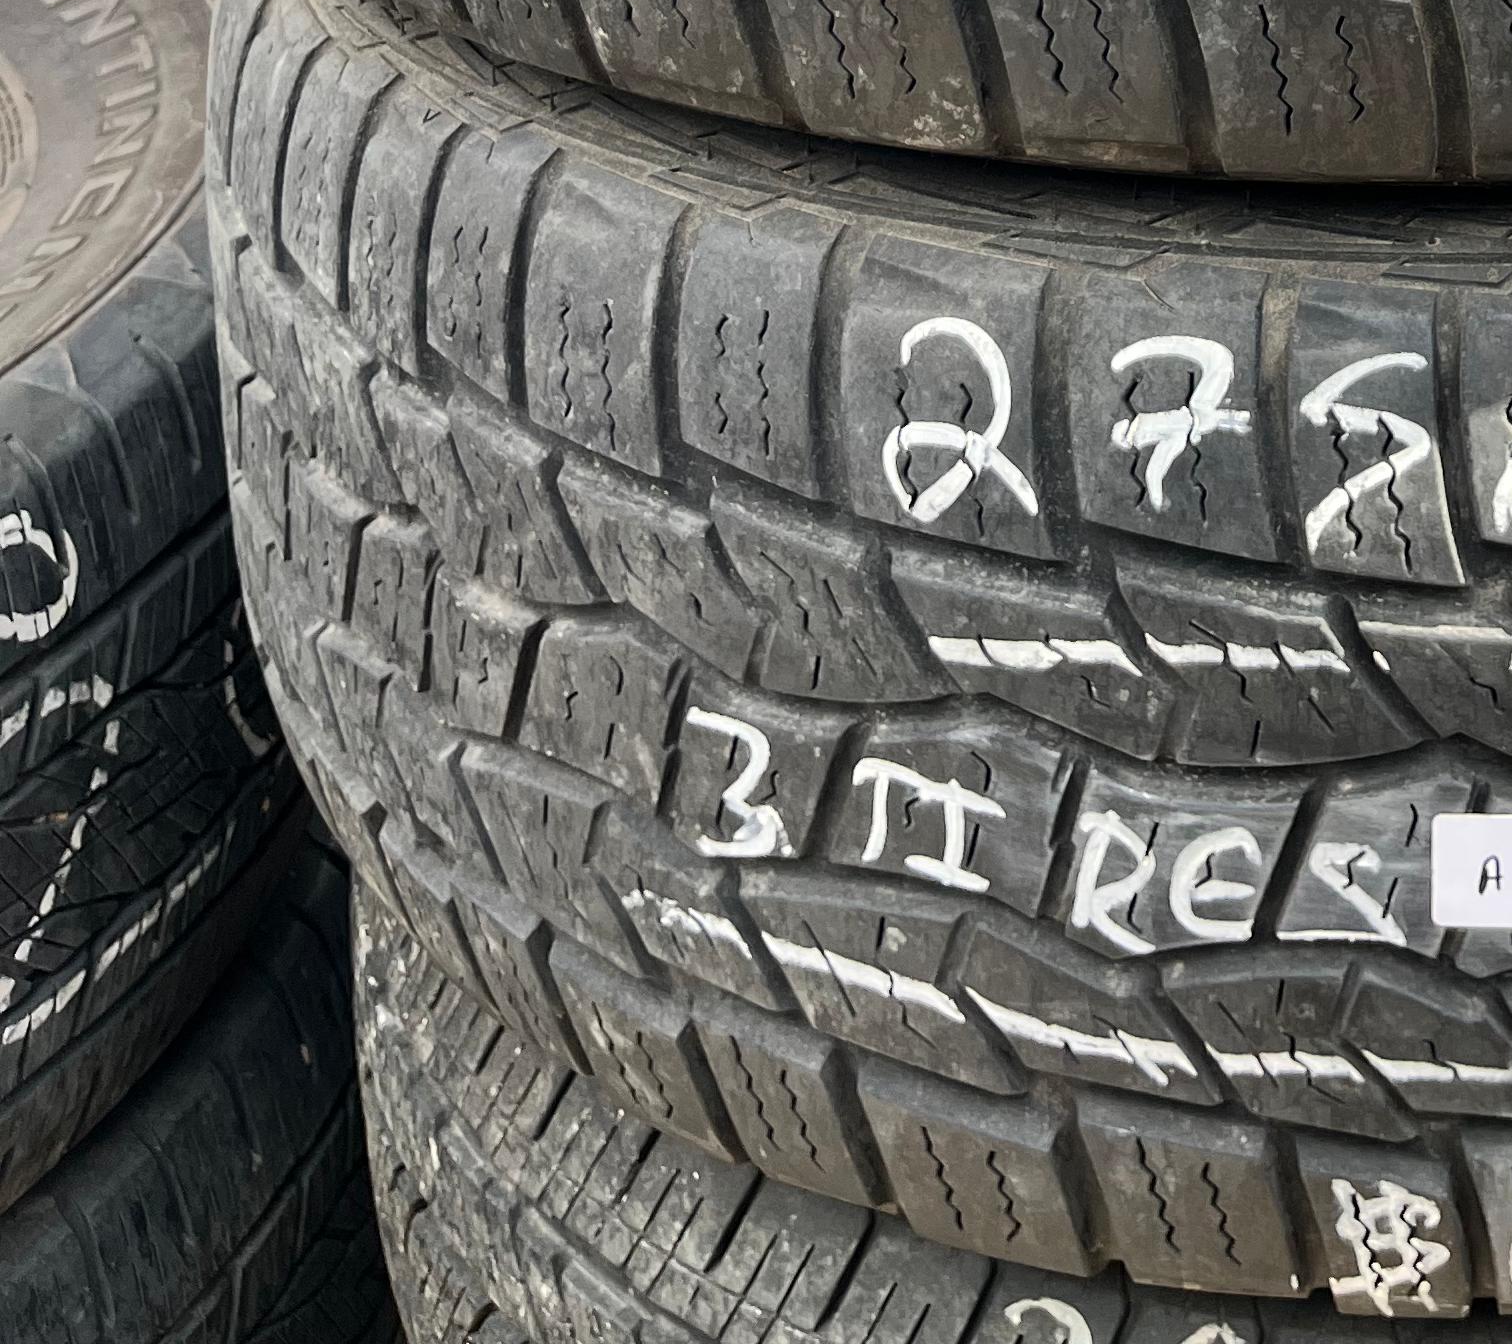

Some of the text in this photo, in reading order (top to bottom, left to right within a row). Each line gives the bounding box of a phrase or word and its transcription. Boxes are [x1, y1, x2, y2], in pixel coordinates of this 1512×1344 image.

[882, 316, 1433, 555] 275
[685, 706, 794, 858] 3
[853, 757, 1409, 957] TIRES
